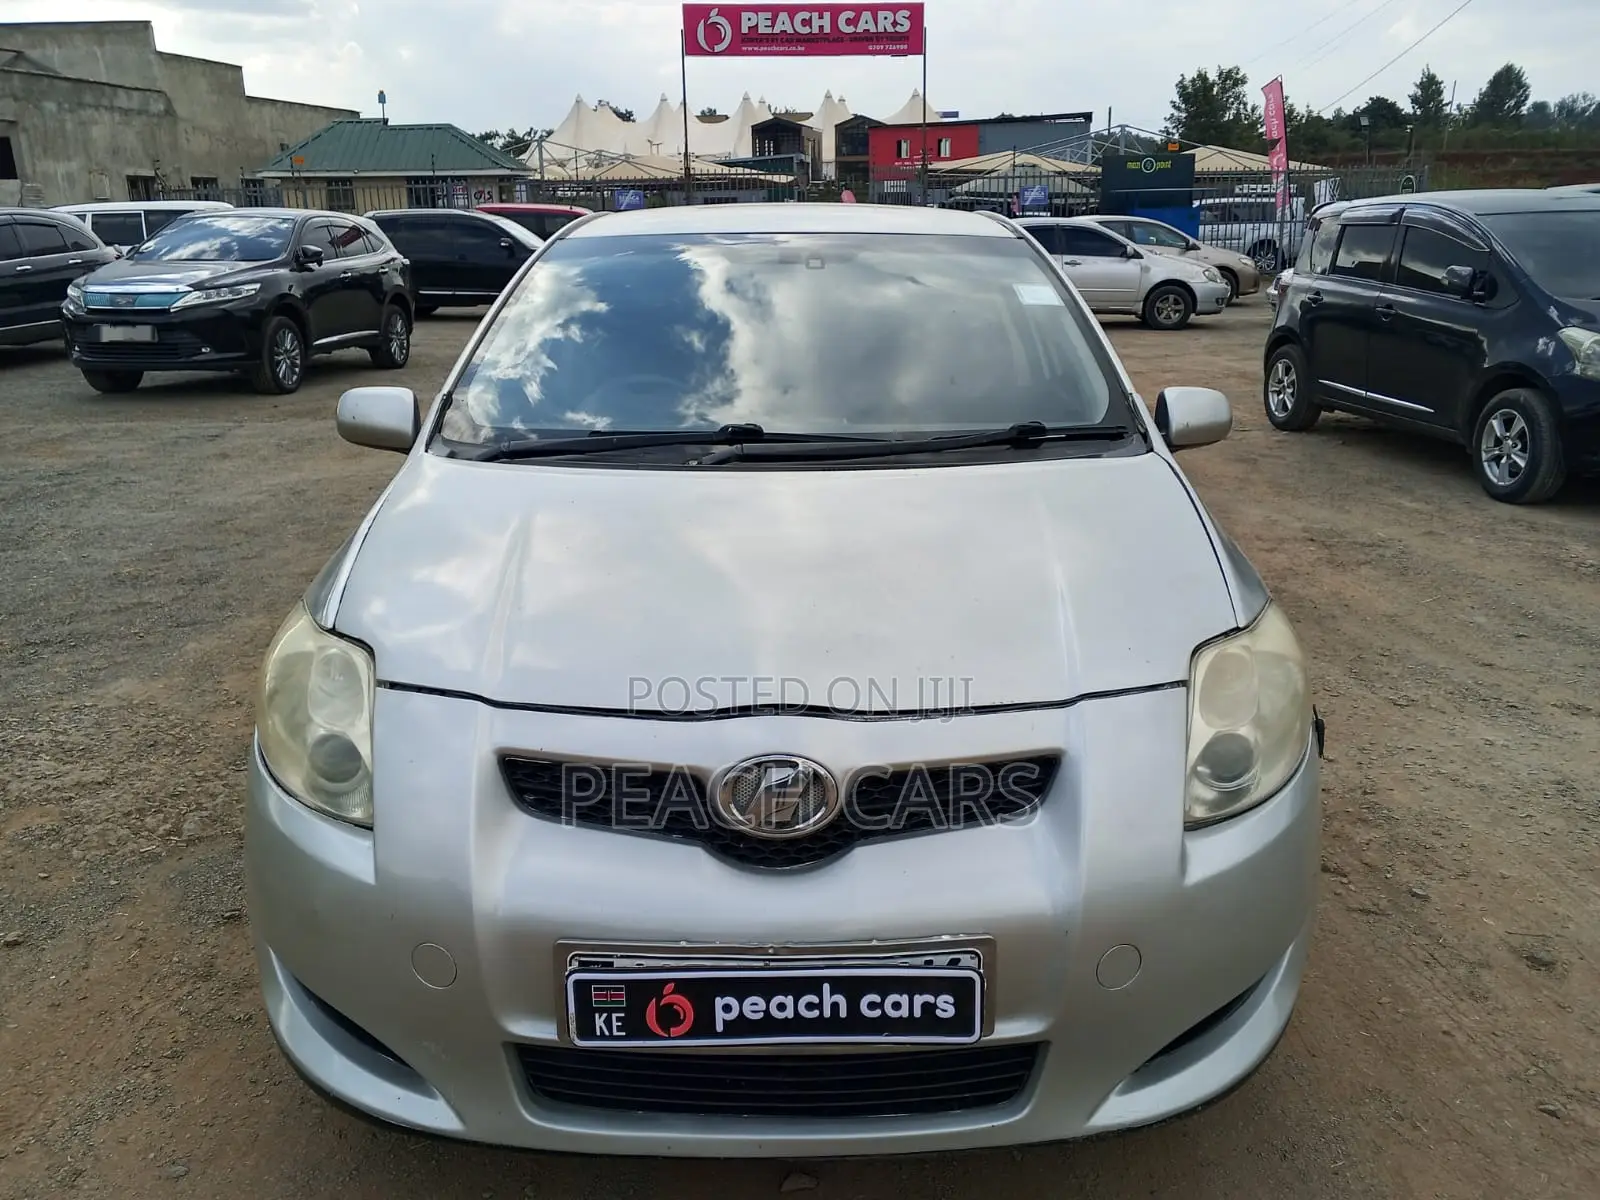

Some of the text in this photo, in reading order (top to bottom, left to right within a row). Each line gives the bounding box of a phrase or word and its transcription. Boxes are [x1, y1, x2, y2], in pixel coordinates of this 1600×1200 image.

[741, 10, 911, 34] PEACH CARS
[595, 982, 957, 1037] KE peach cars
